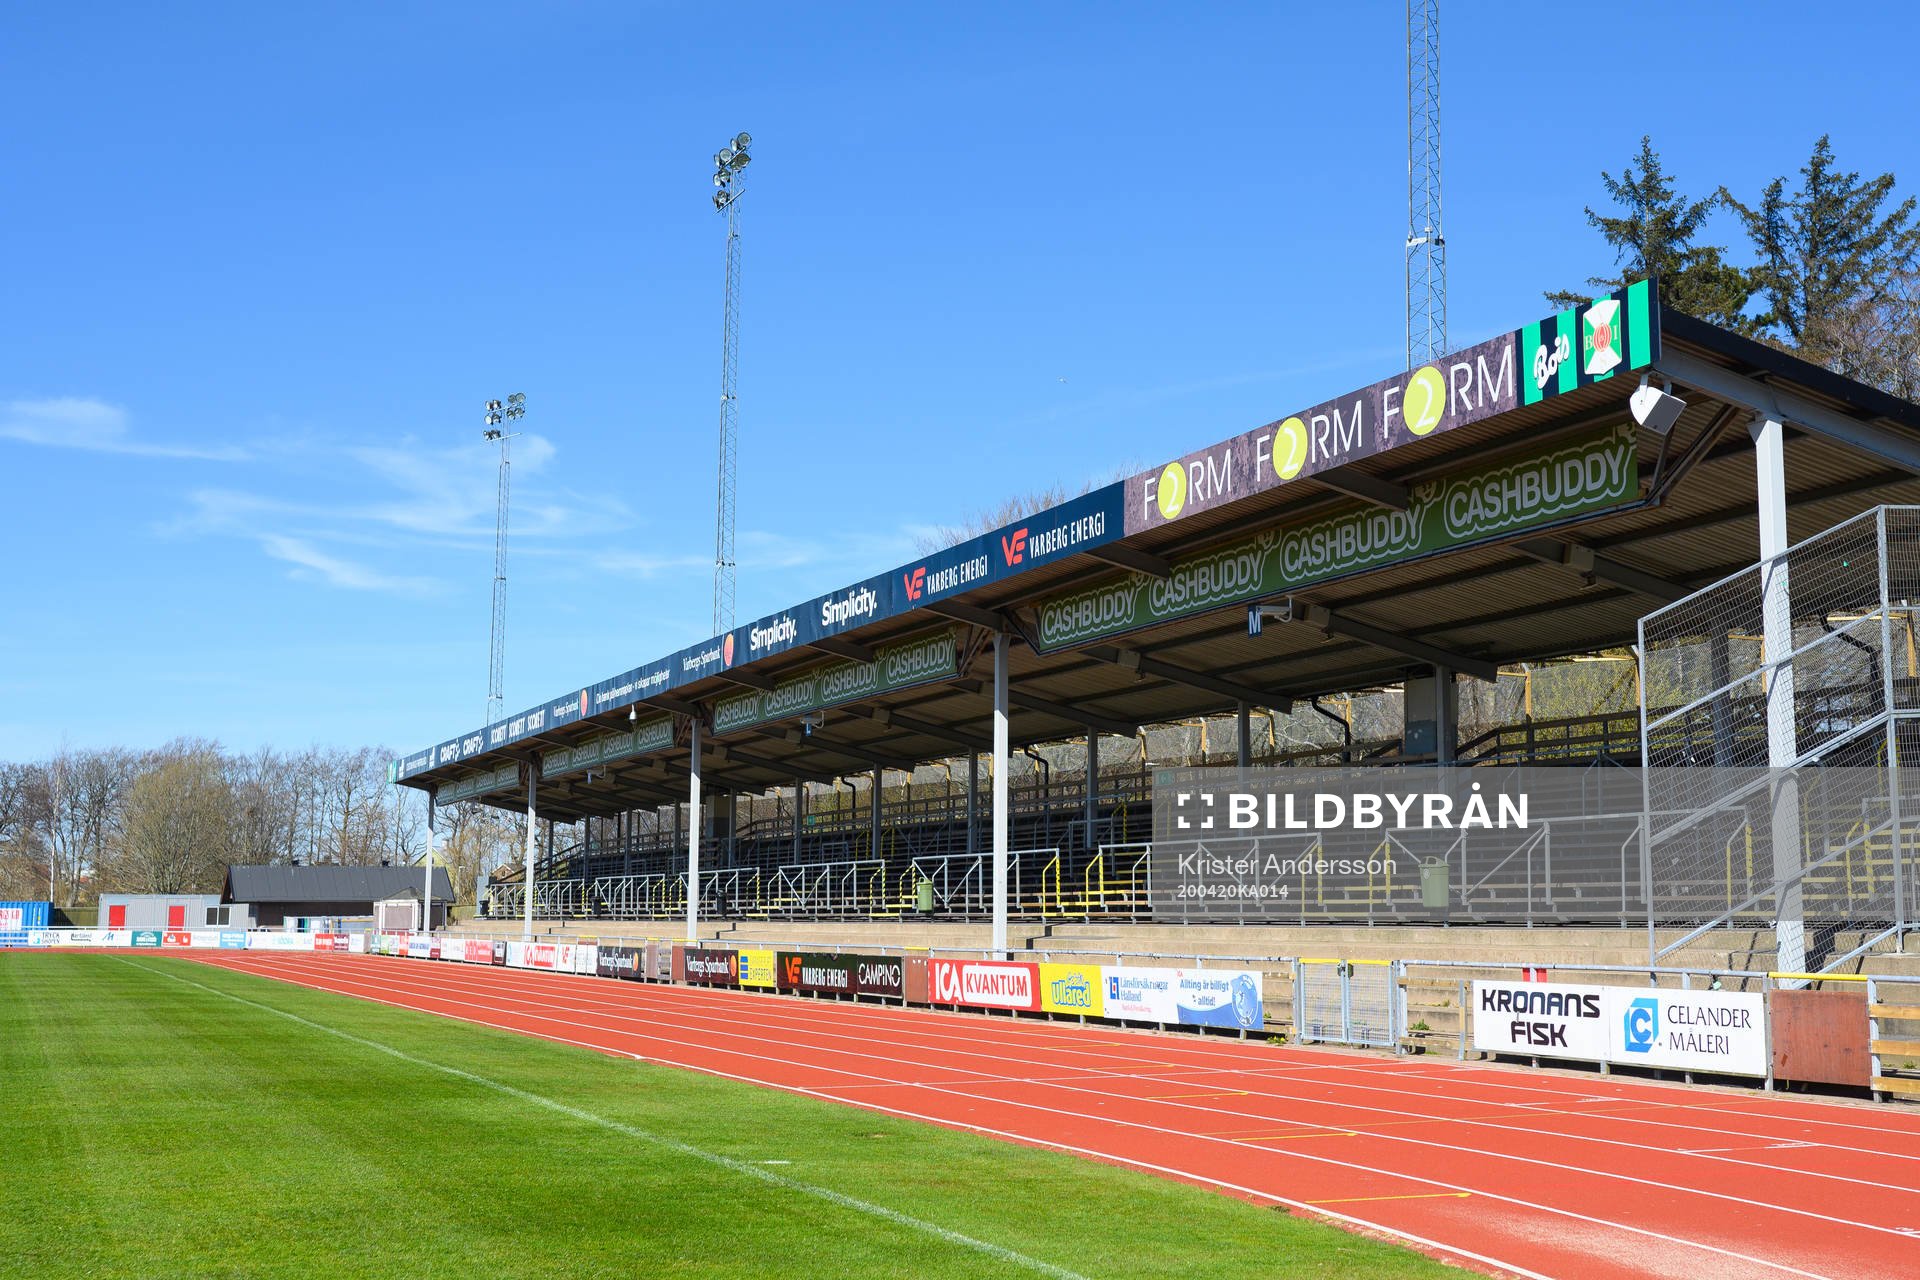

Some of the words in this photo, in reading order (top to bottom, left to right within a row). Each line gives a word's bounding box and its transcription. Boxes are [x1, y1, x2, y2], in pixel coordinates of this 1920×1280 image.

[1534, 334, 1570, 390] Bois
[1449, 445, 1626, 530] CASHBUDDY
[1029, 527, 1068, 560] VARBERG
[1070, 511, 1105, 546] ENERGI
[1283, 504, 1422, 573] CASHBUDDY
[926, 565, 958, 595] VARBERG
[960, 554, 988, 584] ENERGI
[1151, 550, 1263, 608] CASHBUDDY
[822, 586, 878, 626] Simplicity.
[1043, 586, 1137, 637] CASHBUDDY
[751, 614, 797, 651] Simplicity.
[1249, 613, 1262, 635] M
[888, 640, 951, 678] CASHBUDDY
[822, 663, 879, 695] CASHBUDDY
[716, 695, 759, 725] CASHBUDDY
[766, 681, 815, 712] CASHBUDDY
[802, 967, 826, 987] VARBERG
[827, 968, 848, 988] ENERGI
[858, 963, 901, 988] CAMPINO
[935, 962, 963, 1002] ICA
[966, 973, 1028, 997] KVANTUM
[1179, 978, 1201, 992] Allting
[1051, 980, 1092, 1008] Ullared
[1482, 988, 1600, 1019] KRONANS
[1667, 1004, 1752, 1029] CELANDER
[1510, 1020, 1568, 1048] FISK
[1669, 1028, 1729, 1055] MÅLERI
